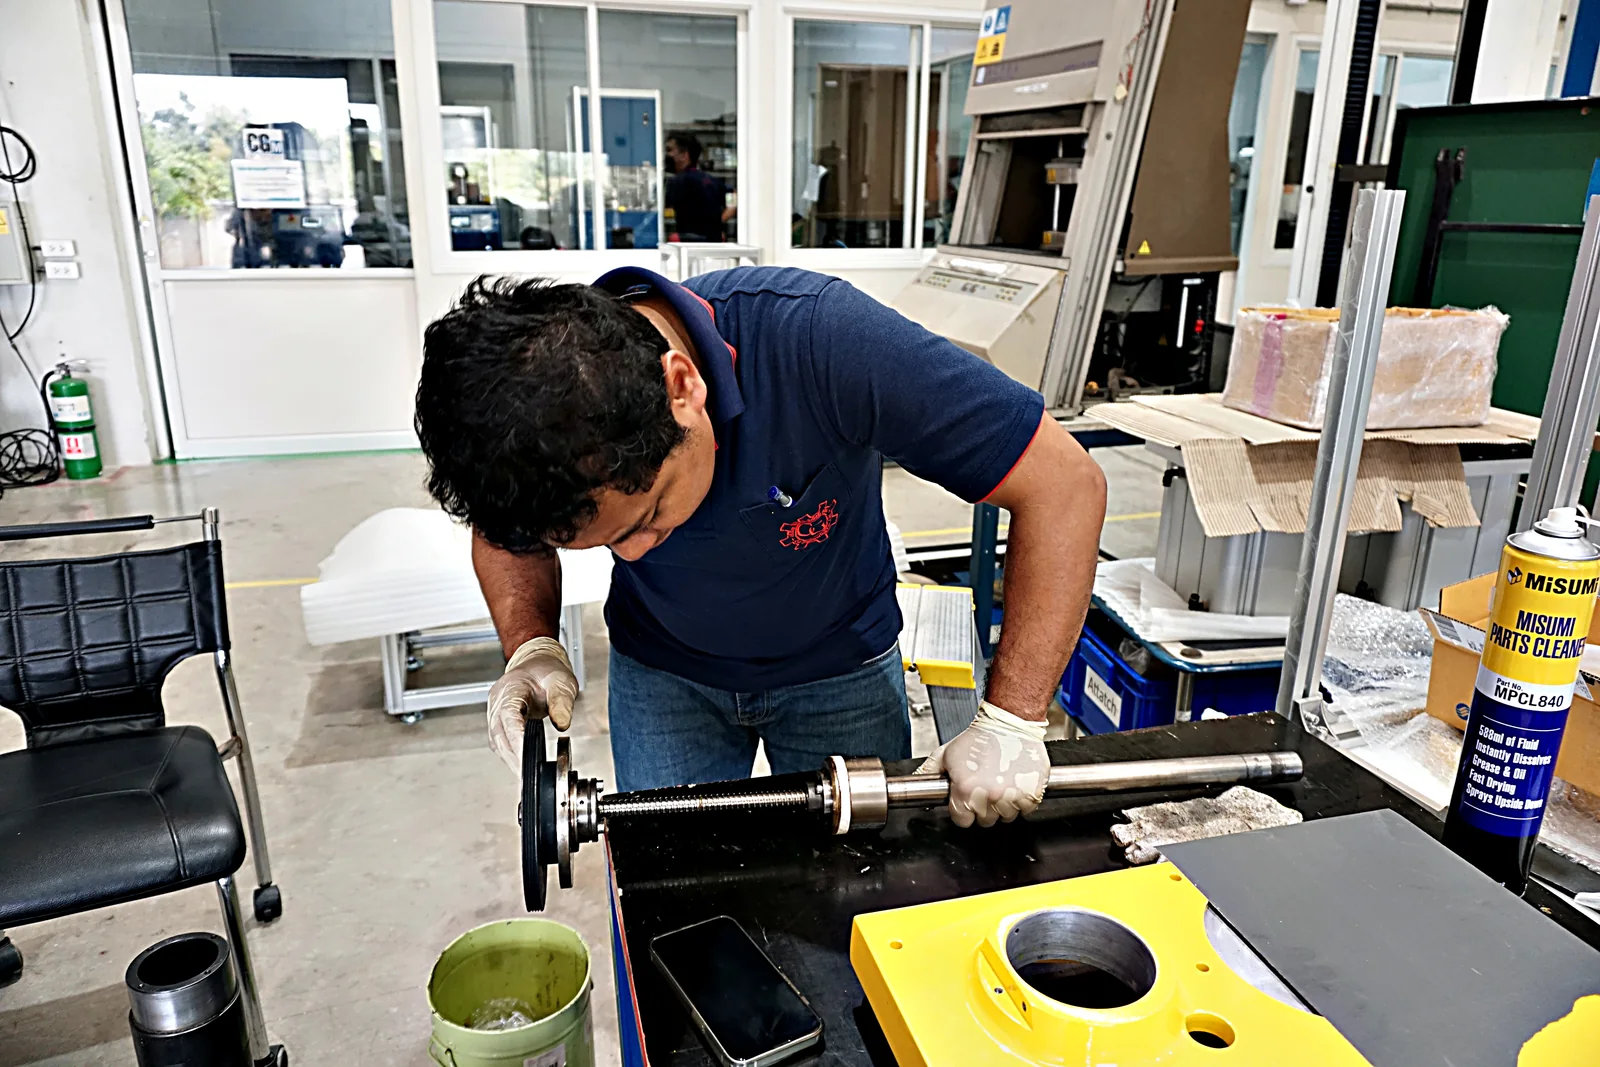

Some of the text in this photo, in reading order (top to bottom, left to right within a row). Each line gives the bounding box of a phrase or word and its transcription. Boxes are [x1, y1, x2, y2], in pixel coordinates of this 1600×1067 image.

[1516, 610, 1576, 636] MISUMI
[1490, 622, 1531, 654] PARTS
[1087, 676, 1117, 716] Attatch
[1494, 684, 1564, 707] MPCL840
[1496, 677, 1523, 691] Part No.
[1478, 724, 1539, 750] 588ml of Fluid
[1475, 739, 1552, 765] Instantly Dissolves
[1472, 754, 1527, 780] Grease & Oil
[1469, 768, 1516, 795] Fast Drying
[1466, 782, 1493, 803] Sprays
[1494, 794, 1524, 810] Upside
